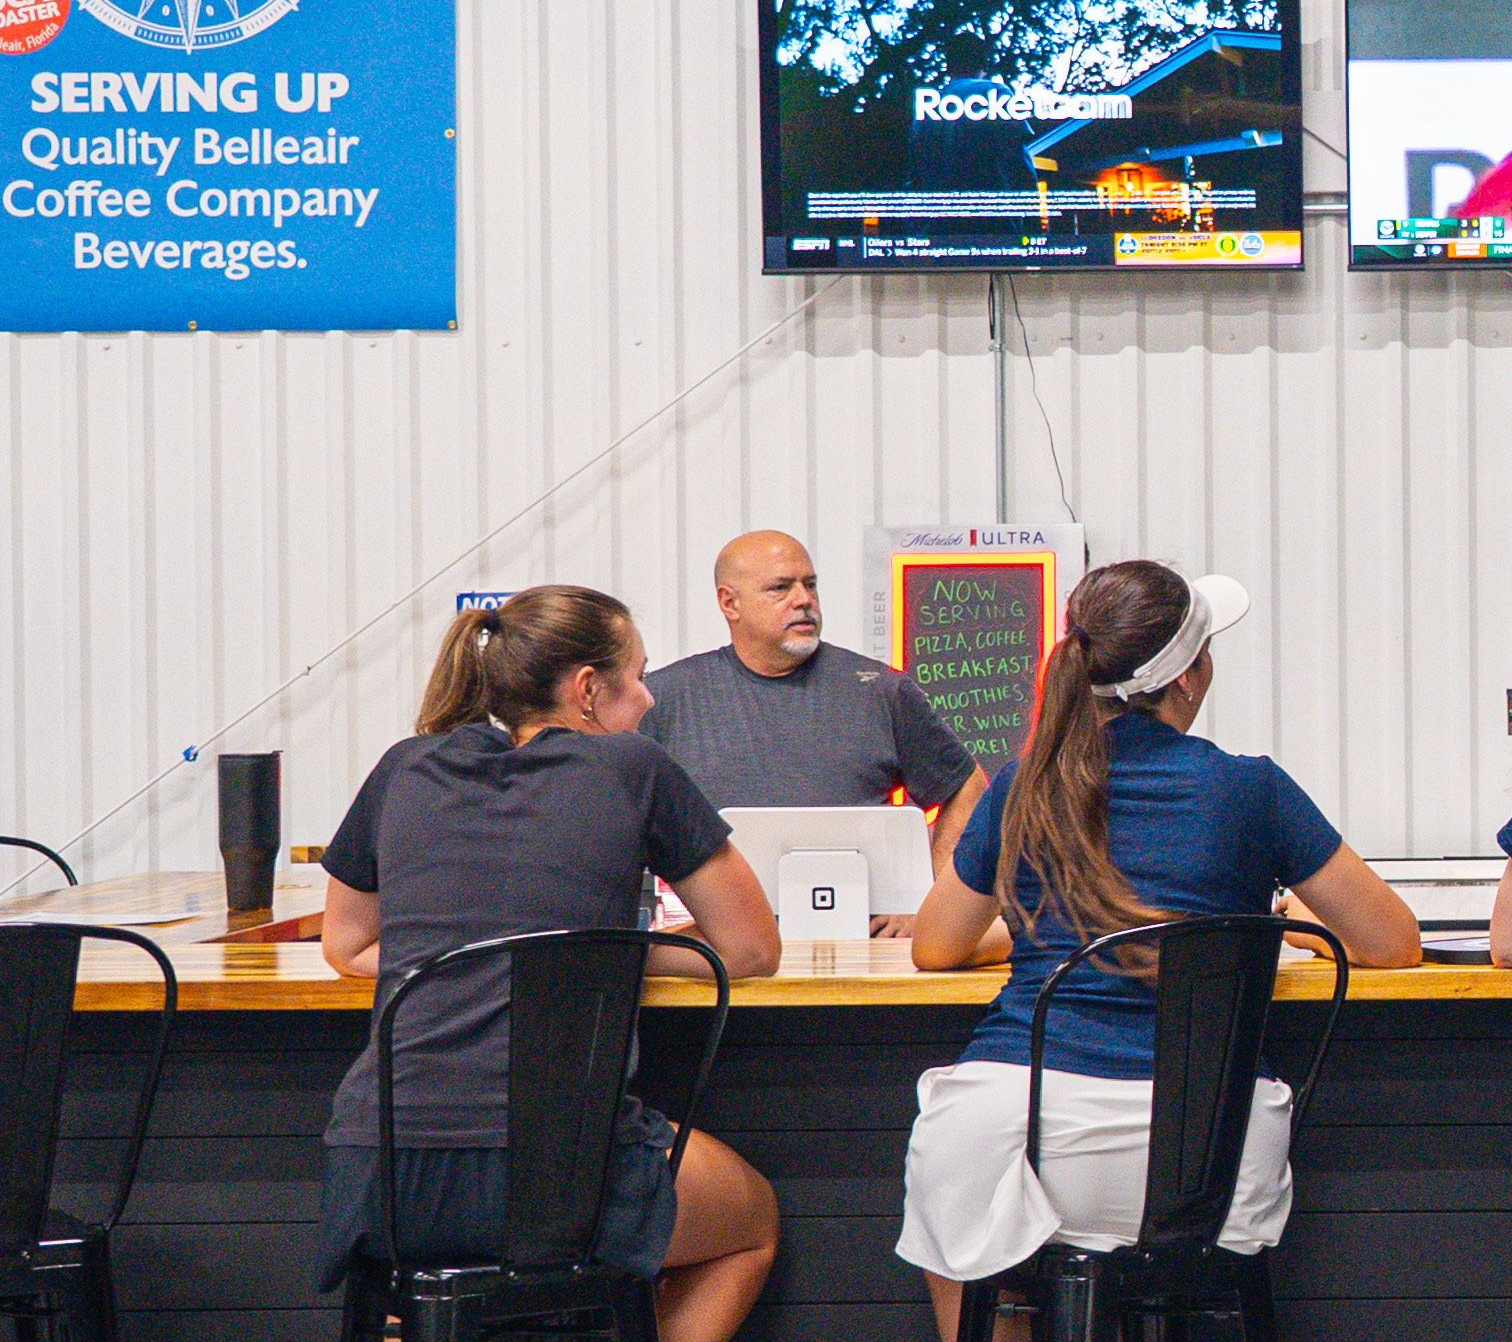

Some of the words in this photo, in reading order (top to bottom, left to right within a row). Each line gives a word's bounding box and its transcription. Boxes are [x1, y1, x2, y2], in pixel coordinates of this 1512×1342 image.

[25, 22, 59, 49] Florida
[31, 71, 258, 113] SERVING
[275, 71, 350, 113] UP
[21, 127, 181, 176] Quality
[194, 128, 360, 166] Belleair
[2, 179, 151, 218] Coffee
[166, 179, 380, 228] Company
[908, 237, 931, 247] Stars
[74, 232, 308, 281] Beverages.
[900, 532, 964, 548] Michelob
[982, 531, 1045, 546] ULTRA
[933, 578, 997, 604] NOW
[873, 591, 886, 636] BEER
[919, 600, 1027, 627] SERVING
[914, 630, 973, 656] PIZZA,
[974, 712, 1022, 730] WINE
[963, 738, 1008, 757] ORE!
